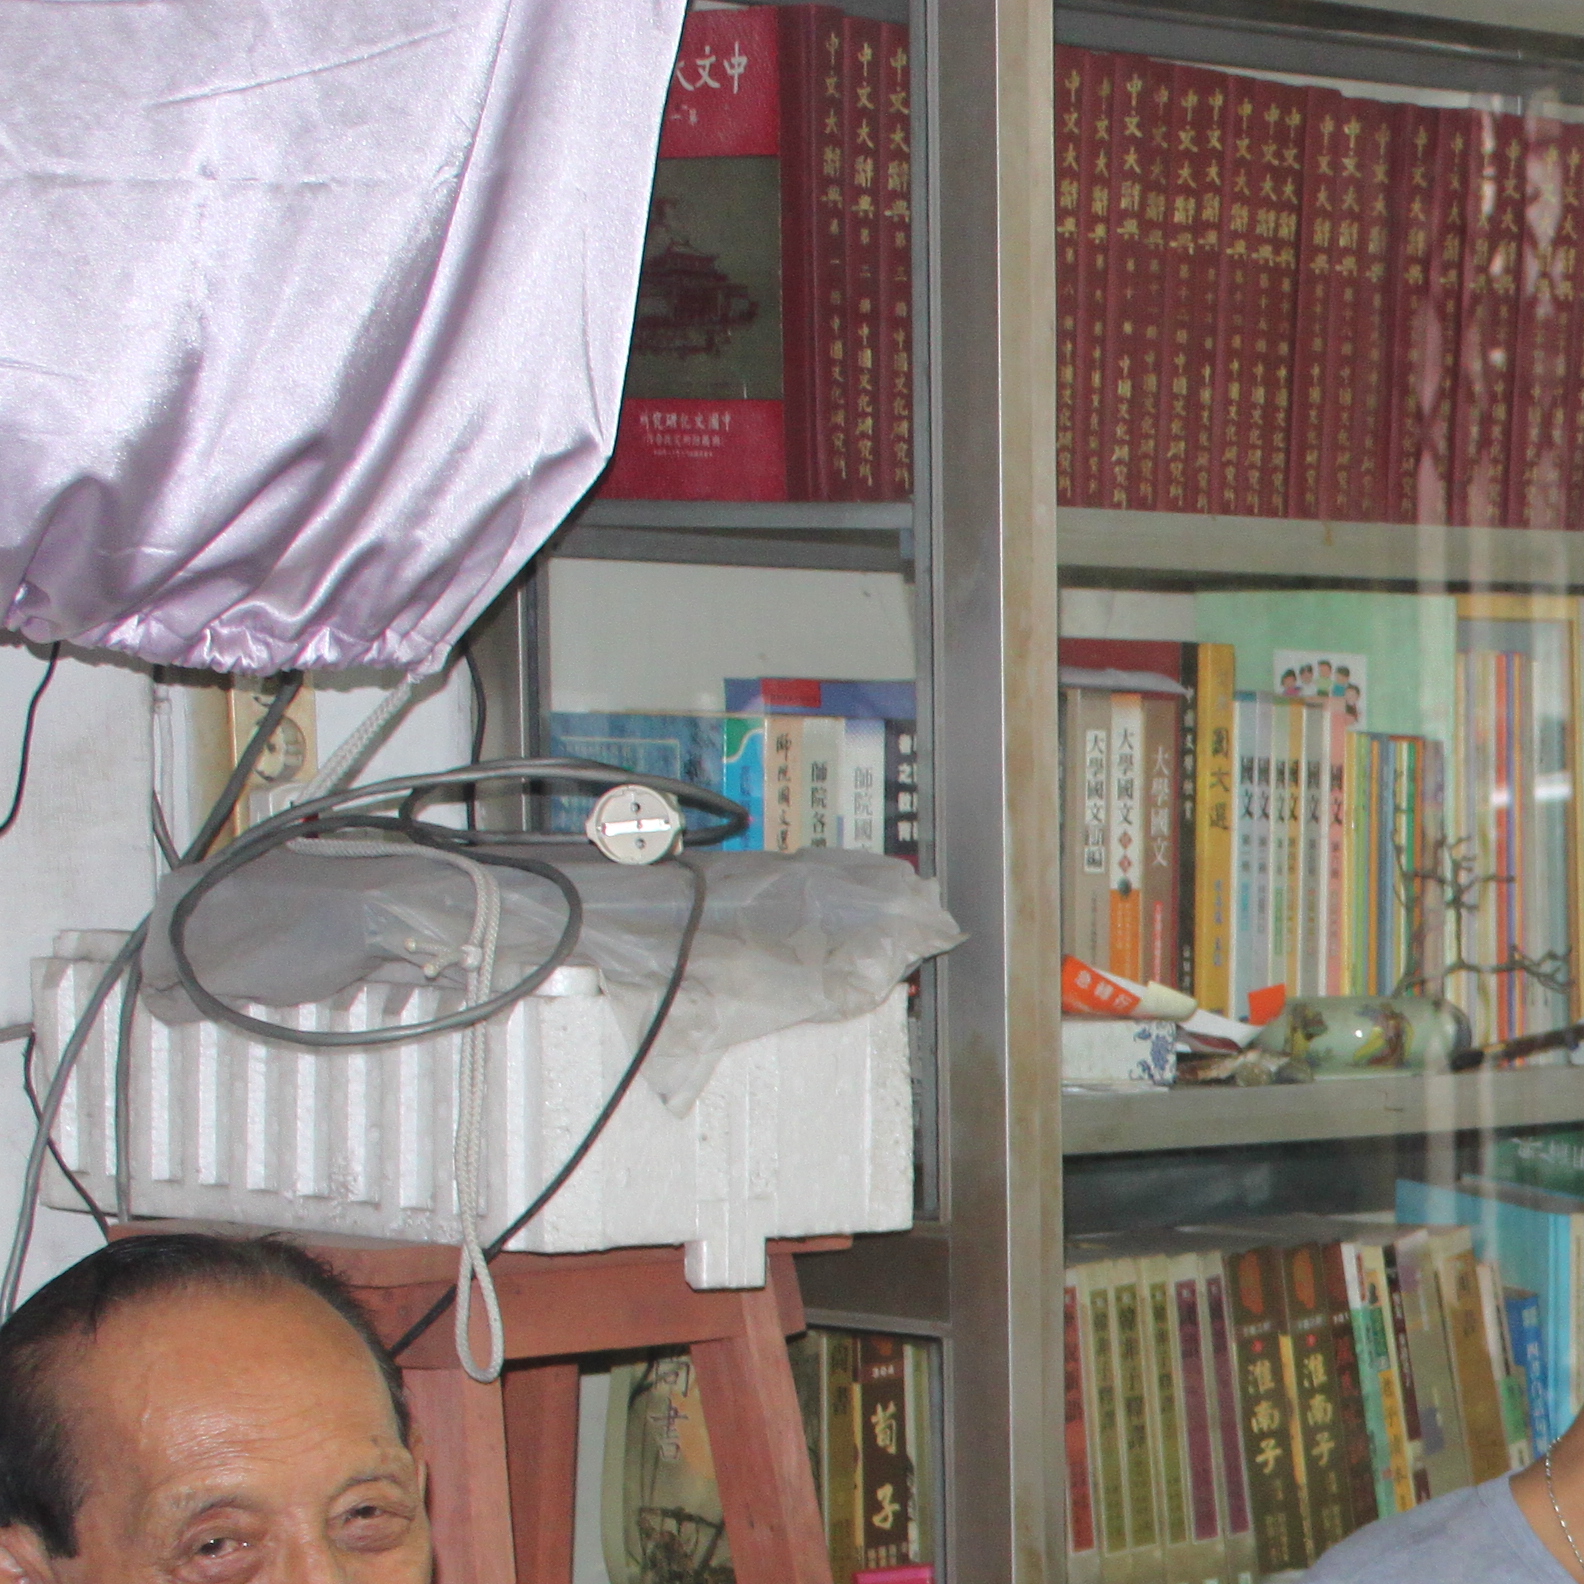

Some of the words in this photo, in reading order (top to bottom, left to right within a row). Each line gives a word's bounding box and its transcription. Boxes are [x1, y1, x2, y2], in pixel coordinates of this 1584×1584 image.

[852, 42, 875, 220] 中文大辭典
[1117, 73, 1143, 241] 中文大辭典
[1169, 88, 1199, 256] 中文大辭典
[1116, 727, 1134, 826] 大學國文
[1150, 746, 1171, 867] 大學國文
[869, 1400, 902, 1531] 荀子
[1303, 1352, 1336, 1467] 淮南子
